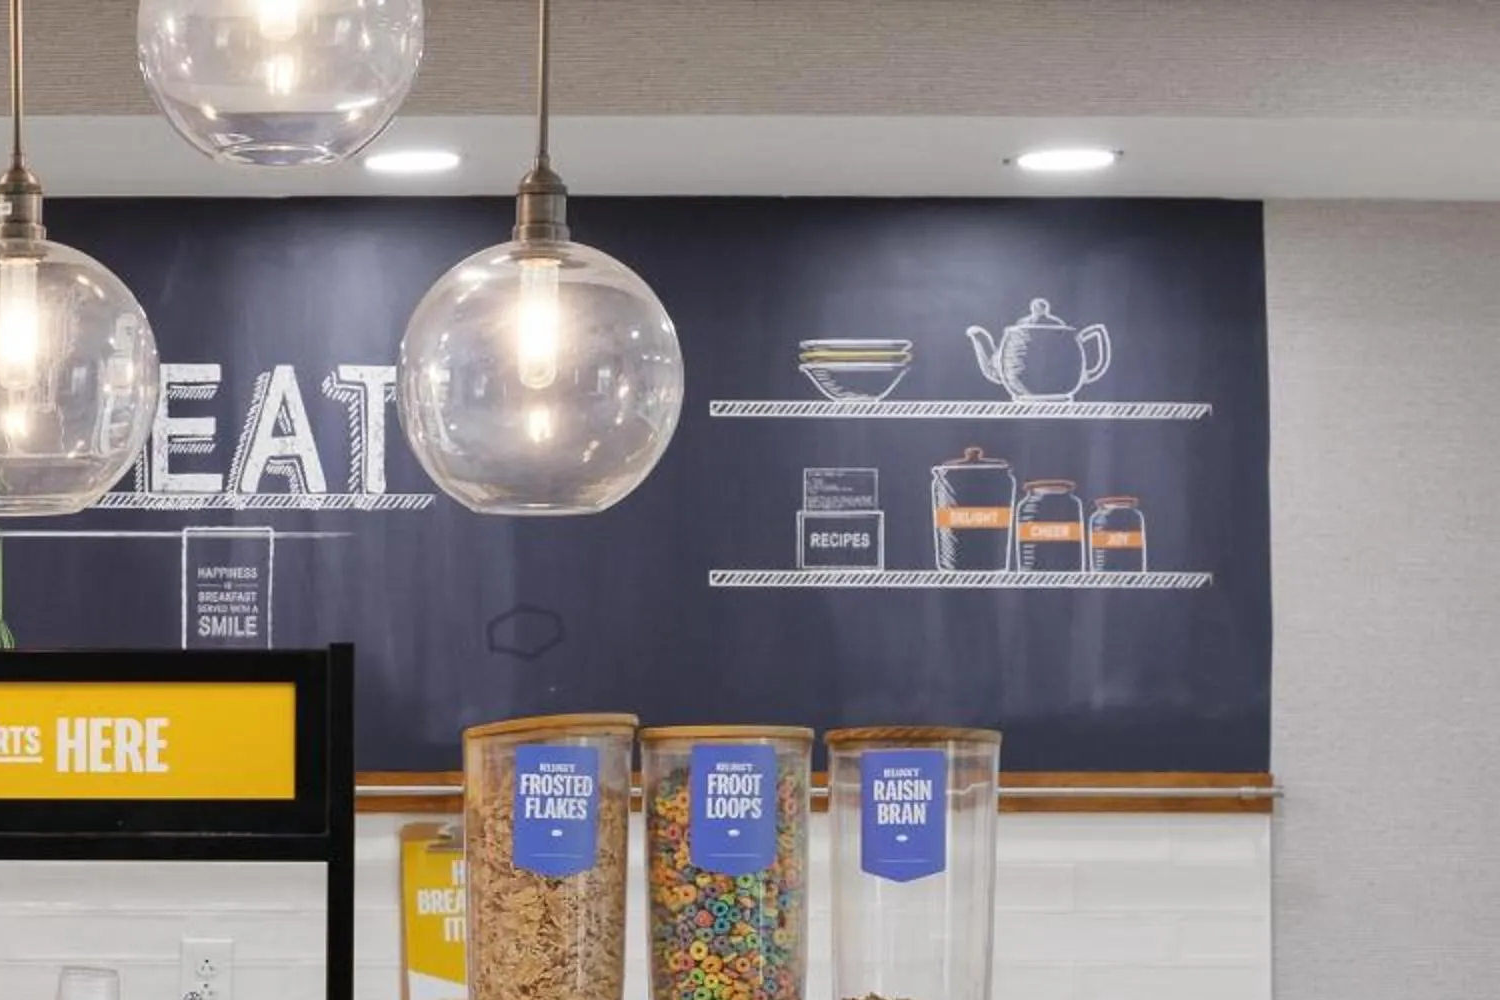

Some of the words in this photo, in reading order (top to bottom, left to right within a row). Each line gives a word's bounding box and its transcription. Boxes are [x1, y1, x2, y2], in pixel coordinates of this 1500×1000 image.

[149, 363, 398, 494] EAT
[809, 531, 871, 549] RECIPES
[197, 567, 259, 579] HAPPINESS
[198, 615, 259, 637] SMILE
[55, 716, 170, 773] HERE
[520, 773, 594, 797] FROSTED
[707, 773, 763, 796] FROOT
[873, 779, 933, 801] RAISIN
[525, 797, 589, 819] FLAKES
[706, 797, 763, 819] LOOPS
[877, 802, 927, 825] BRAN
